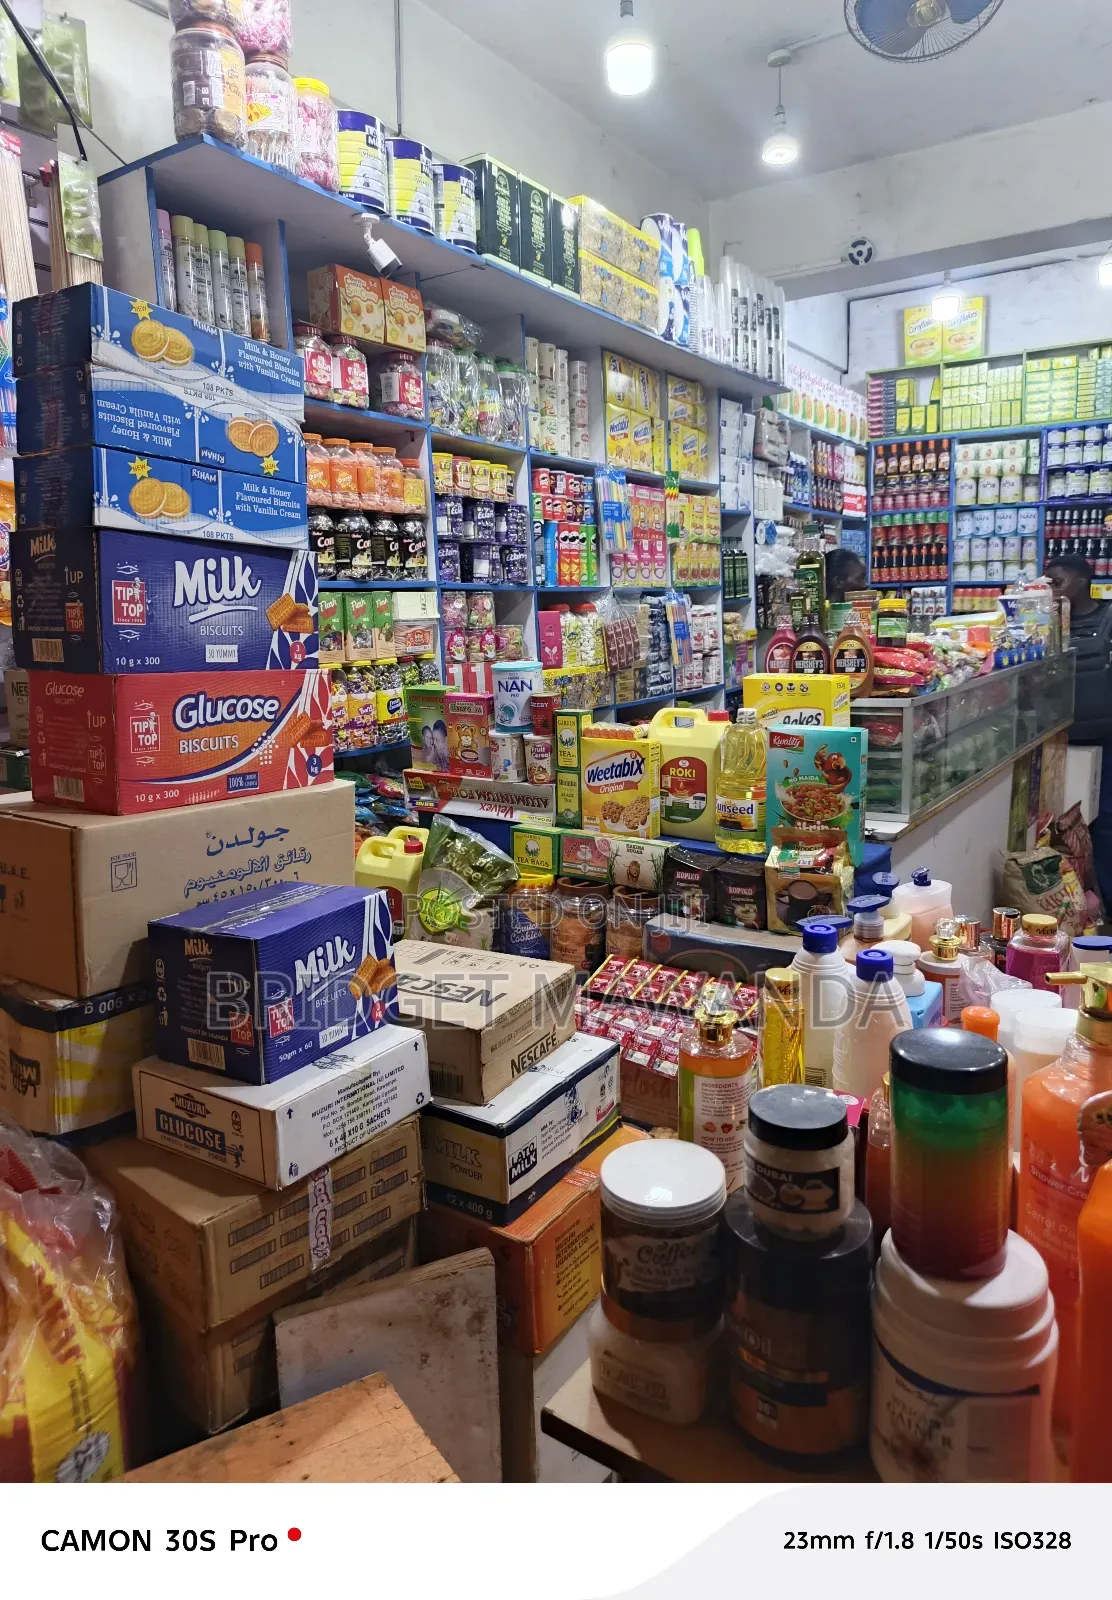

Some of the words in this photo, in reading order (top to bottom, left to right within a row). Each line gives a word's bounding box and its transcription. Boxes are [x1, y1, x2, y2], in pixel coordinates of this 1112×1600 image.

[133, 304, 147, 313] NEW
[192, 318, 218, 336] RIHAM
[244, 341, 260, 353] Milk
[261, 347, 268, 356] &
[269, 350, 291, 366] Honey
[237, 349, 273, 368] Flavoured
[274, 362, 300, 378] Biscuits
[237, 360, 254, 372] with
[256, 364, 279, 380] Vanilla
[280, 375, 301, 388] Cream
[183, 387, 203, 399] PKTS
[202, 382, 214, 392] 108
[215, 386, 234, 397] PKTS
[96, 399, 126, 414] Cream
[128, 406, 160, 422] Vanilla
[98, 411, 135, 427] Biscuits
[162, 414, 182, 425] with
[111, 424, 140, 441] Honey
[138, 420, 181, 438] Flavoured
[142, 432, 150, 442] &
[152, 434, 172, 447] Milk
[201, 449, 225, 464] RIHAM
[132, 463, 146, 472] NEW
[191, 468, 217, 482] RIHAM
[243, 482, 260, 493] Milk
[261, 486, 268, 494] &
[269, 487, 291, 499] Honey
[235, 491, 271, 505] Flavoured
[273, 498, 300, 509] Biscuits
[235, 503, 251, 512] with
[252, 504, 278, 515] Vanilla
[279, 509, 301, 520] Cream
[30, 533, 57, 557] Milk
[69, 571, 84, 584] UP
[173, 556, 262, 607] Milk
[115, 587, 134, 601] TIP
[67, 608, 77, 618] TIP
[121, 603, 144, 617] TOP
[71, 620, 83, 629] TOP
[200, 625, 244, 636] BISCUITS
[295, 644, 300, 652] 3
[115, 657, 127, 666] 10
[128, 658, 135, 668] g
[144, 657, 160, 665] 300
[293, 652, 302, 662] kg
[795, 660, 824, 669] HERSHEY'S
[836, 659, 865, 668] HERSHEY'S
[11, 682, 28, 696] NES
[45, 681, 85, 697] Glucose
[497, 679, 533, 692] NAN
[174, 694, 280, 730] Glucose
[93, 716, 107, 728] UP
[132, 721, 148, 733] TIP
[138, 734, 158, 747] TOP
[179, 735, 239, 754] BISCUITS
[772, 735, 801, 748] Kwality
[89, 749, 98, 759] TIP
[93, 760, 105, 770] TOP
[310, 765, 319, 774] kg
[587, 757, 646, 784] Weetabix
[669, 767, 696, 778] ROKI
[134, 793, 146, 802] 10
[148, 794, 154, 802] g
[163, 789, 180, 799] 300
[599, 782, 625, 795] Original
[479, 802, 514, 819] Velvex
[122, 851, 137, 859] FOOD
[517, 856, 530, 864] TEA
[531, 857, 550, 868] BAGS
[675, 871, 700, 881] KOPIKO
[728, 886, 753, 896] KOPIKO
[510, 930, 543, 944] Cookies
[183, 938, 213, 957] Milk
[294, 936, 356, 996] Milk
[315, 987, 347, 1009] BISCUITS
[269, 1007, 285, 1021] TIP
[276, 1015, 293, 1030] TOP
[235, 1029, 252, 1040] TOP
[278, 1049, 297, 1063] 50gm
[304, 1040, 313, 1049] 60
[511, 1023, 558, 1079] NESCAFÉ
[311, 1103, 334, 1119] MUZURI
[334, 1081, 377, 1106] INTERNATIONAL
[384, 1064, 405, 1078] LIMITED
[337, 1074, 372, 1096] Manufactured
[175, 1096, 206, 1116] MUZURI
[329, 1139, 333, 1148] 6
[334, 1136, 339, 1144] X
[359, 1122, 364, 1130] G
[366, 1107, 391, 1127] SACHETS
[332, 1116, 343, 1125] BOX
[159, 1113, 223, 1151] GLUCOSE
[334, 1136, 358, 1154] PRODUCT
[359, 1131, 367, 1140] OF
[366, 1119, 388, 1135] UGANDA
[431, 1137, 482, 1169] MILK
[510, 1141, 535, 1167] LATO
[450, 1162, 483, 1182] POWDER
[511, 1152, 537, 1179] MILK
[756, 1166, 793, 1182] DUBAI
[1030, 1164, 1065, 1191] Shower
[467, 1202, 484, 1215] 400
[486, 1209, 493, 1220] g
[1025, 1202, 1056, 1229] Carrot
[555, 1246, 578, 1268] UGANDA
